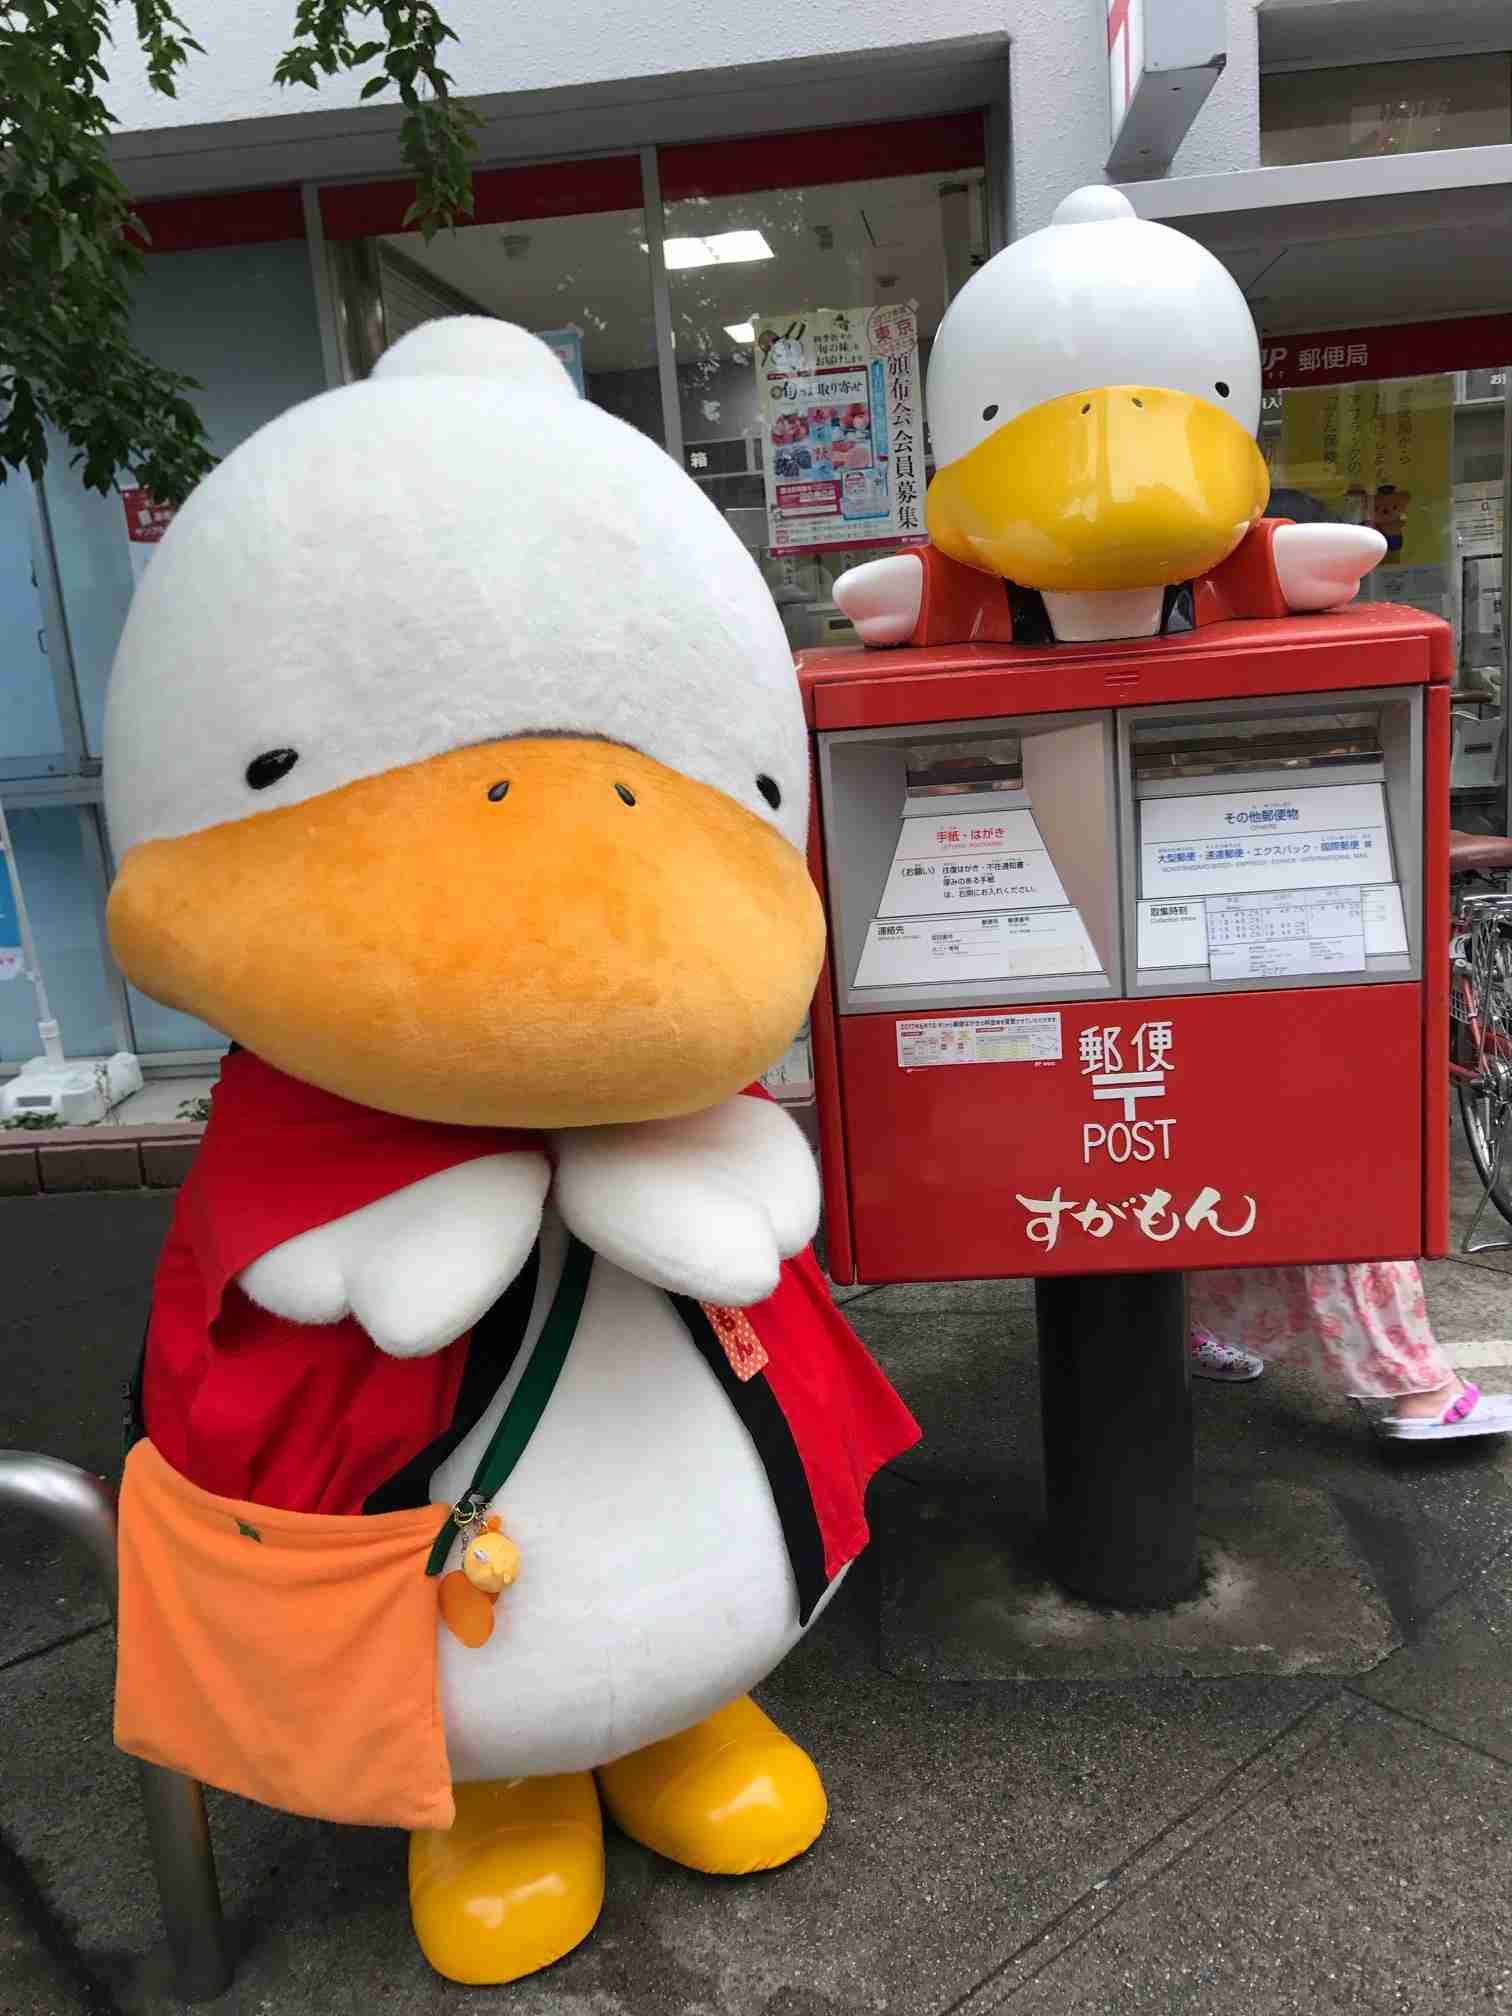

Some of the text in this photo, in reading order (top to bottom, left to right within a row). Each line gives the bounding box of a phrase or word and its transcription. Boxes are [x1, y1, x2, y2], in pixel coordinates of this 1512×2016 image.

[1298, 344, 1368, 371] 郵便局
[1224, 808, 1299, 824] その他郵便物
[936, 828, 1005, 843] 手紙・はがき
[1078, 1020, 1176, 1074] 郵便
[1083, 1118, 1176, 1164] POST
[1016, 1186, 1257, 1252] すがもん
